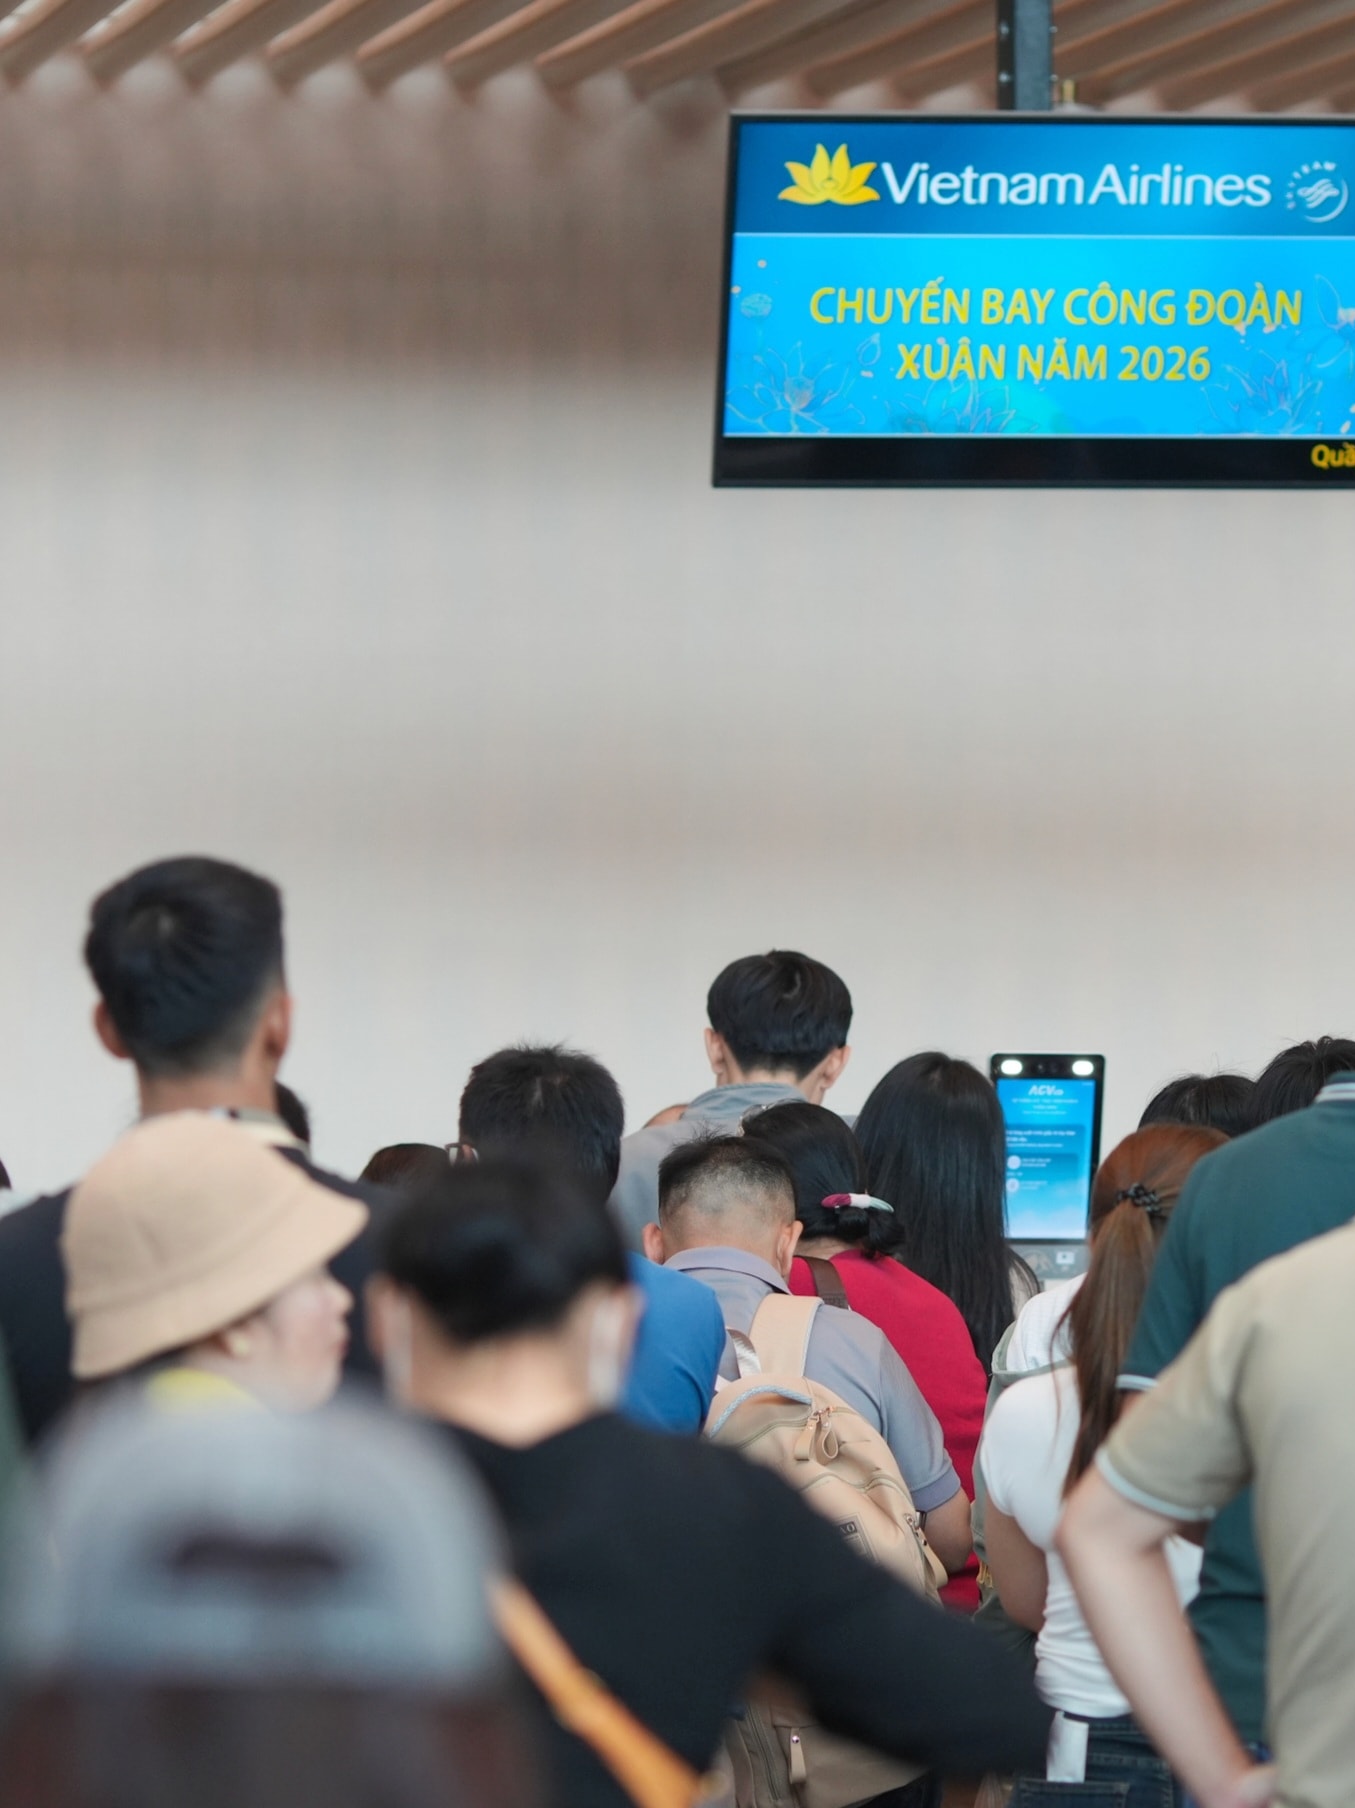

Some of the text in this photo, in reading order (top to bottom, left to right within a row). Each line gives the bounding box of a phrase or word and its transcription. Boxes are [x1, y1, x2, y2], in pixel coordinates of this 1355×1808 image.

[881, 162, 1272, 207] Vietnam Airlines
[809, 276, 1302, 326] CHUYẾN BAY CÔNG ĐOÀN
[896, 336, 1211, 381] XUÂN NĂM 2026
